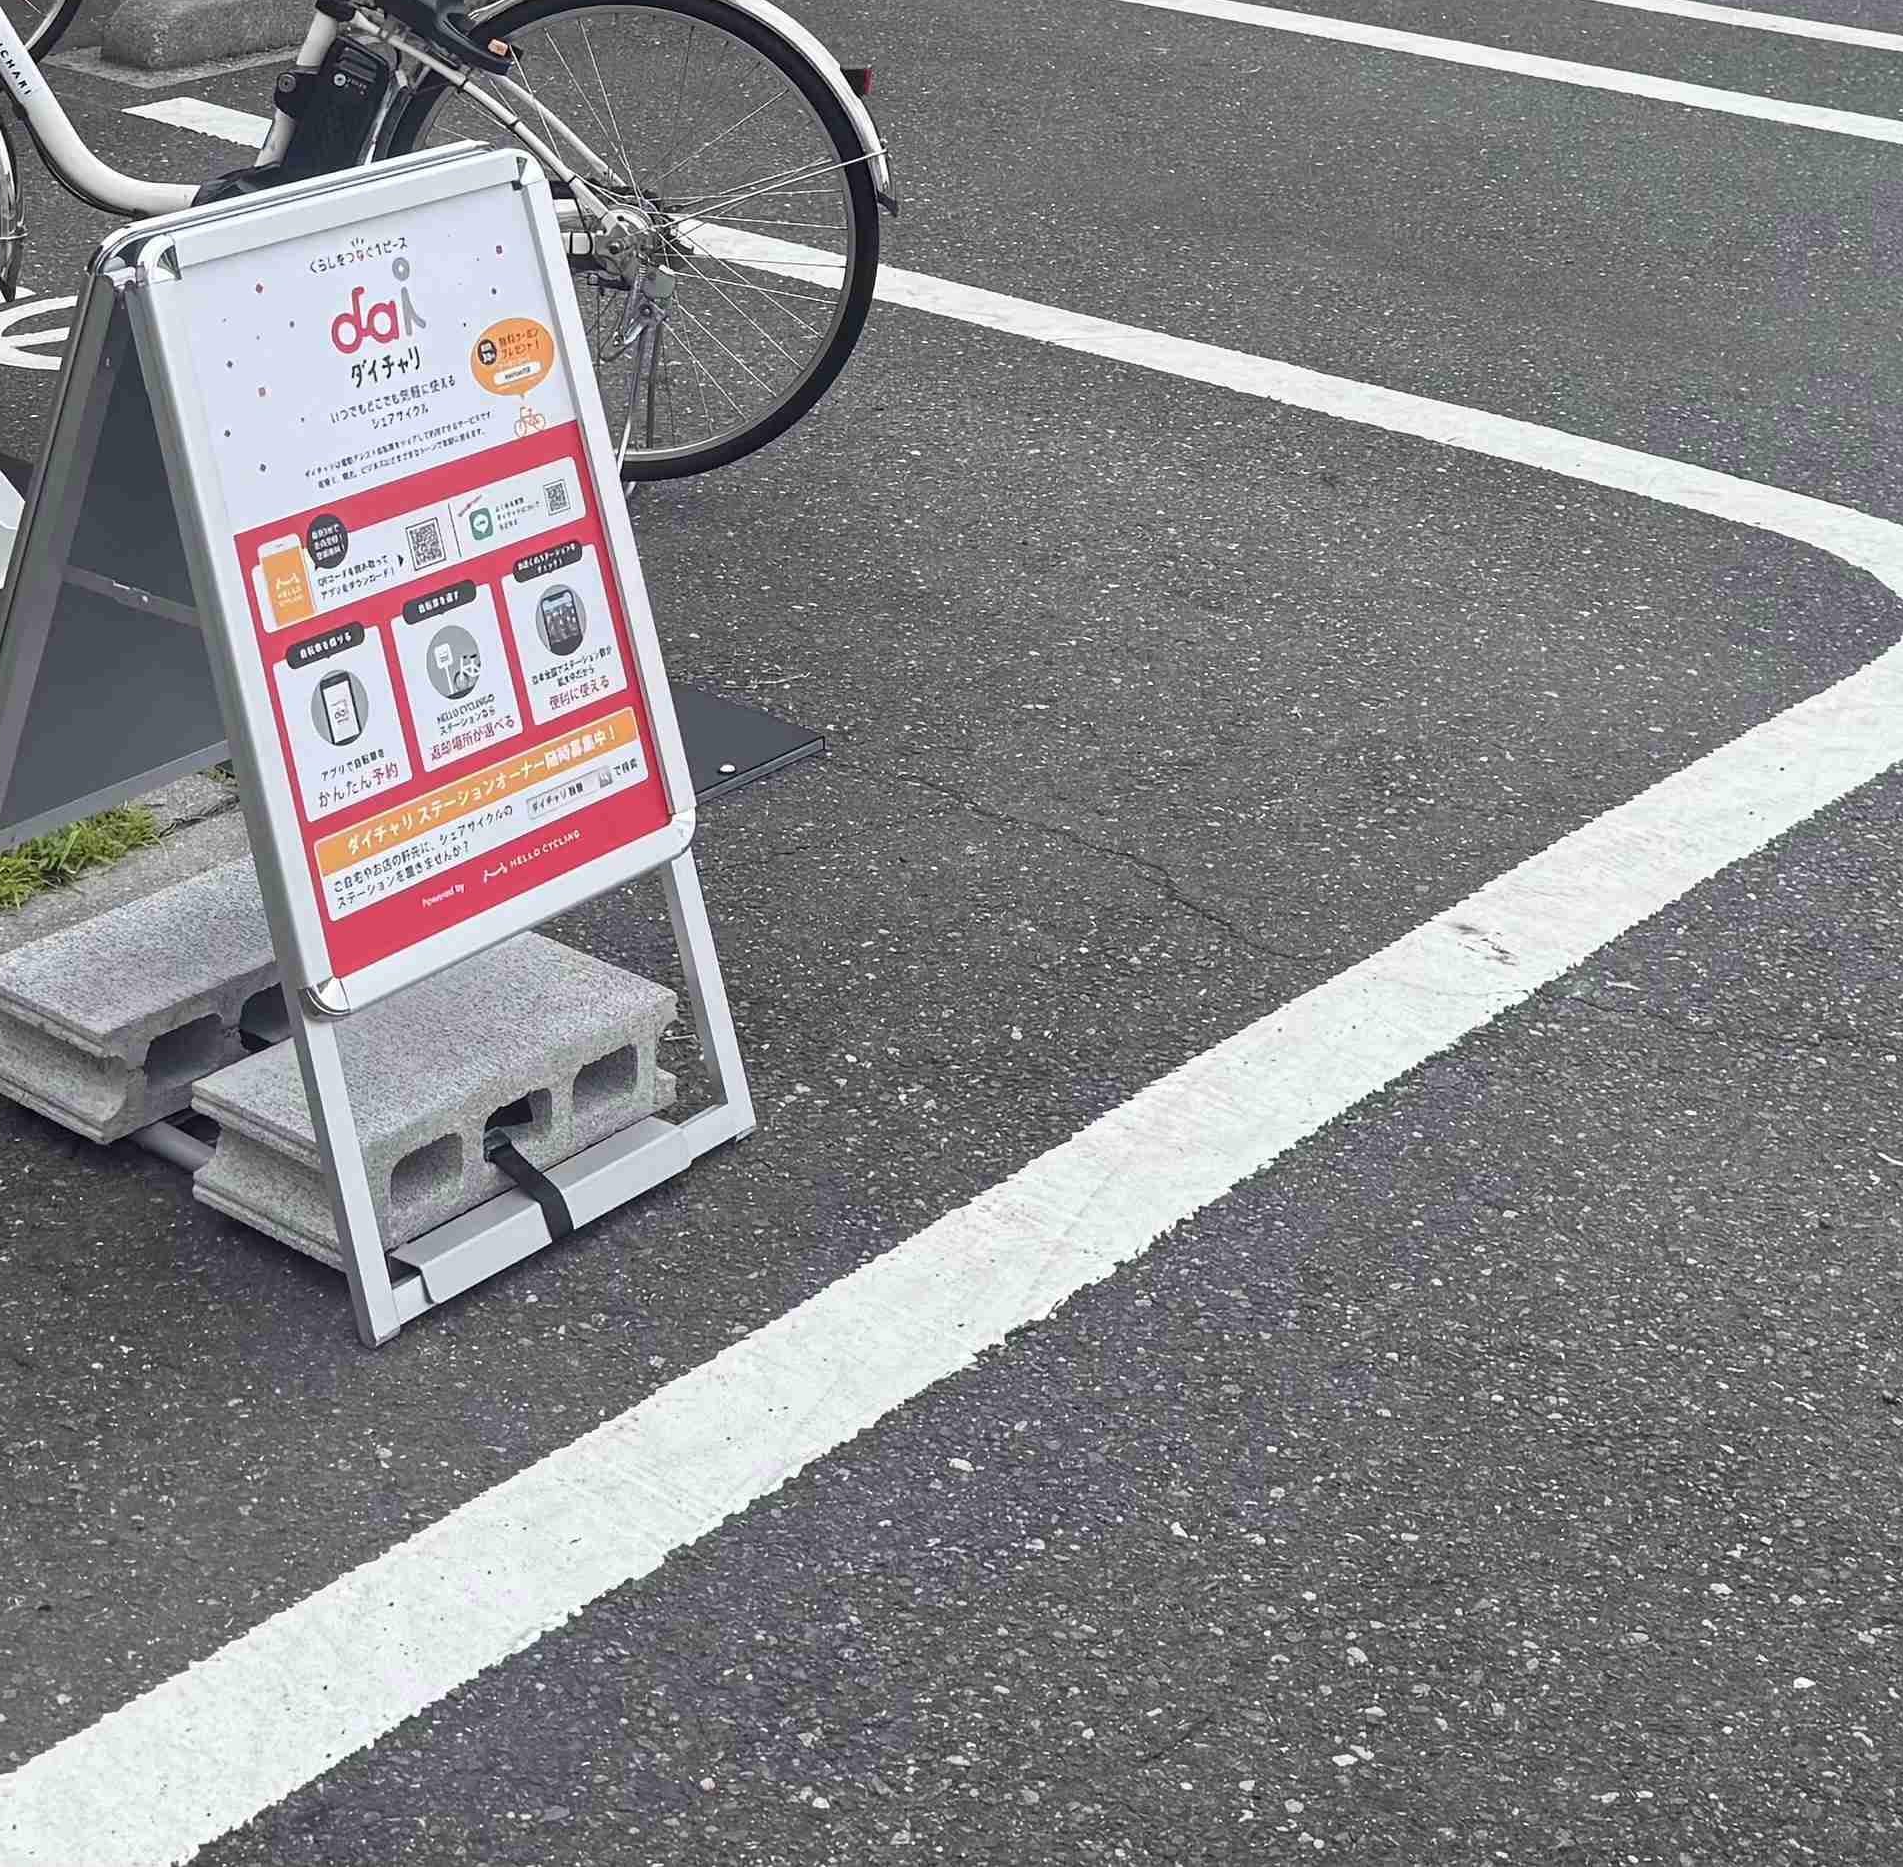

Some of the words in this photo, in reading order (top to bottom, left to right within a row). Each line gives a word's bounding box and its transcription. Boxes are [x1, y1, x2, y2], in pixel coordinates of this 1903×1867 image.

[331, 257, 426, 354] dai
[351, 346, 421, 389] ダイチャリ
[371, 403, 430, 431] シェアサイクル
[319, 762, 400, 808] かんたん予約
[347, 817, 417, 856] ダイチャリ
[508, 850, 540, 868] HELLO
